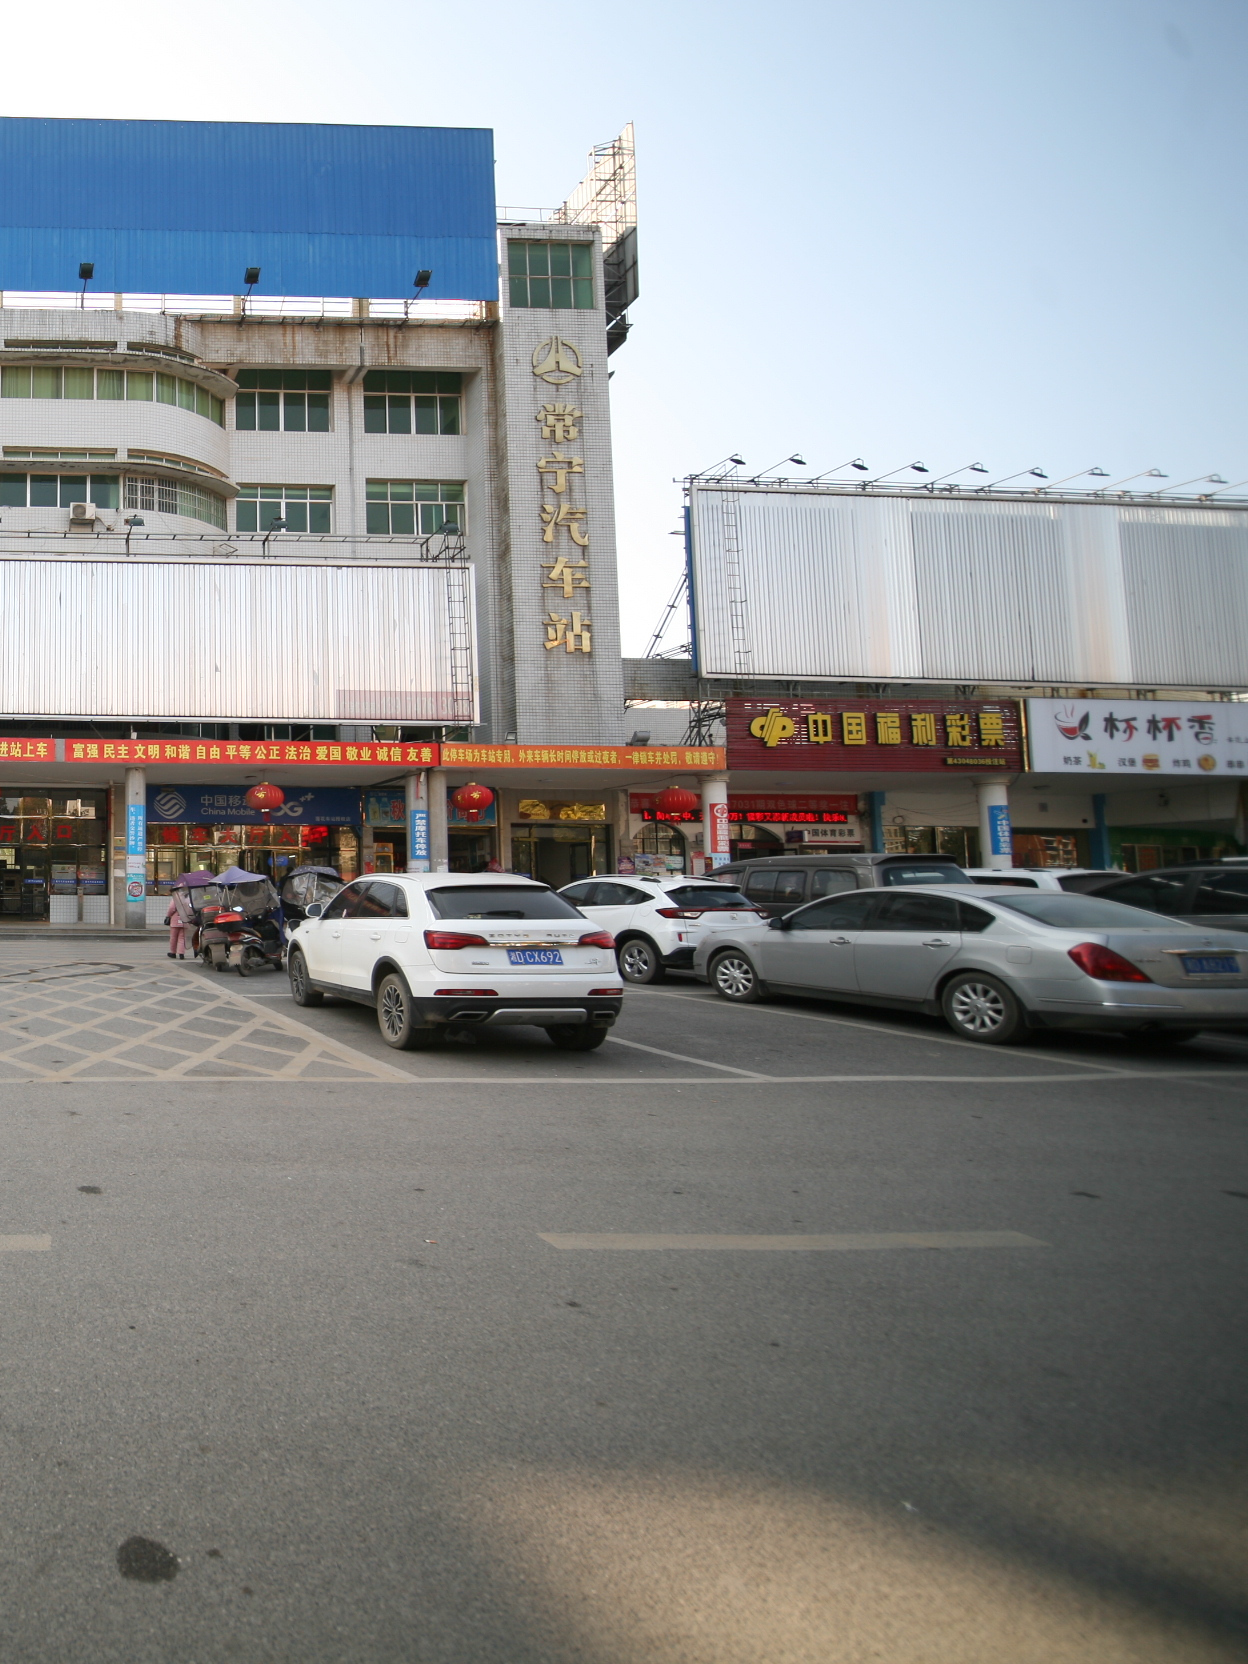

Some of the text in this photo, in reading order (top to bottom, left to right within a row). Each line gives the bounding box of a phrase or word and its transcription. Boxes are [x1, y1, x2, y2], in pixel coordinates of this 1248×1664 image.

[535, 403, 592, 654] 常宁汽车站
[807, 712, 1005, 747] 中国福利彩票
[1103, 711, 1217, 746] 杯杯香
[73, 743, 432, 763] 富强 民主 文明 和谐 自由 平等 公正 法治 爱国 敬业 诚信 友善
[200, 807, 256, 816] China Mobile
